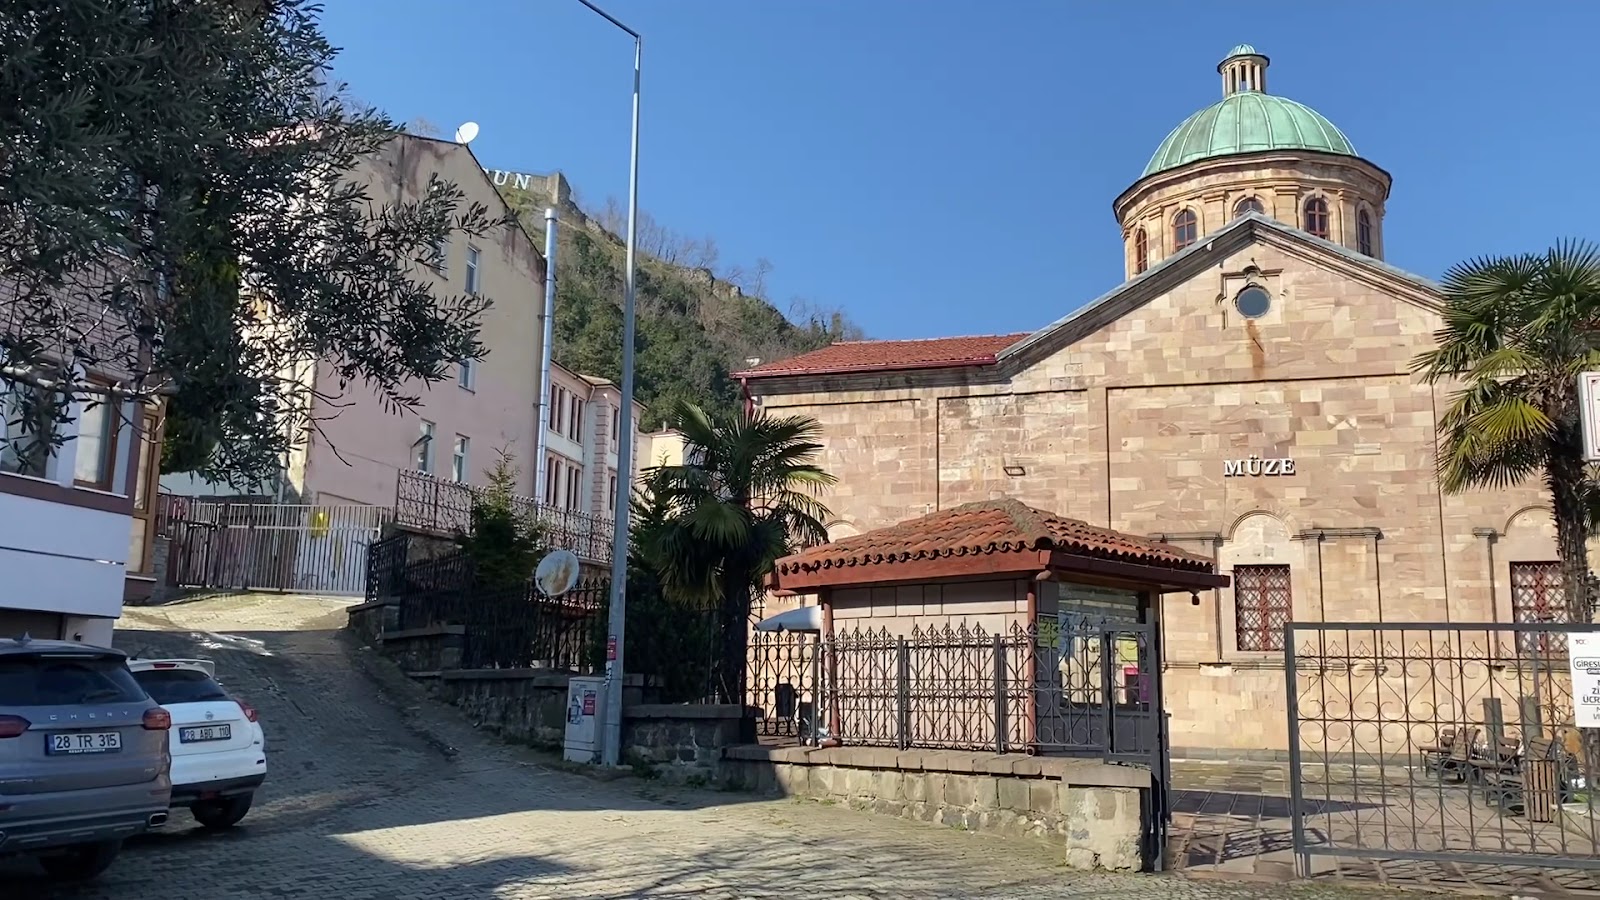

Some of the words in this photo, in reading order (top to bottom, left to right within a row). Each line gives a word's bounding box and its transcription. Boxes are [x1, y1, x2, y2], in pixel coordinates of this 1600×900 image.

[482, 167, 531, 190] UN
[1224, 454, 1296, 477] MÜZE
[50, 710, 128, 720] CHERY
[185, 730, 196, 740] 28
[219, 726, 230, 737] 110
[55, 736, 71, 749] 28
[76, 735, 93, 748] TR
[98, 734, 117, 747] 315
